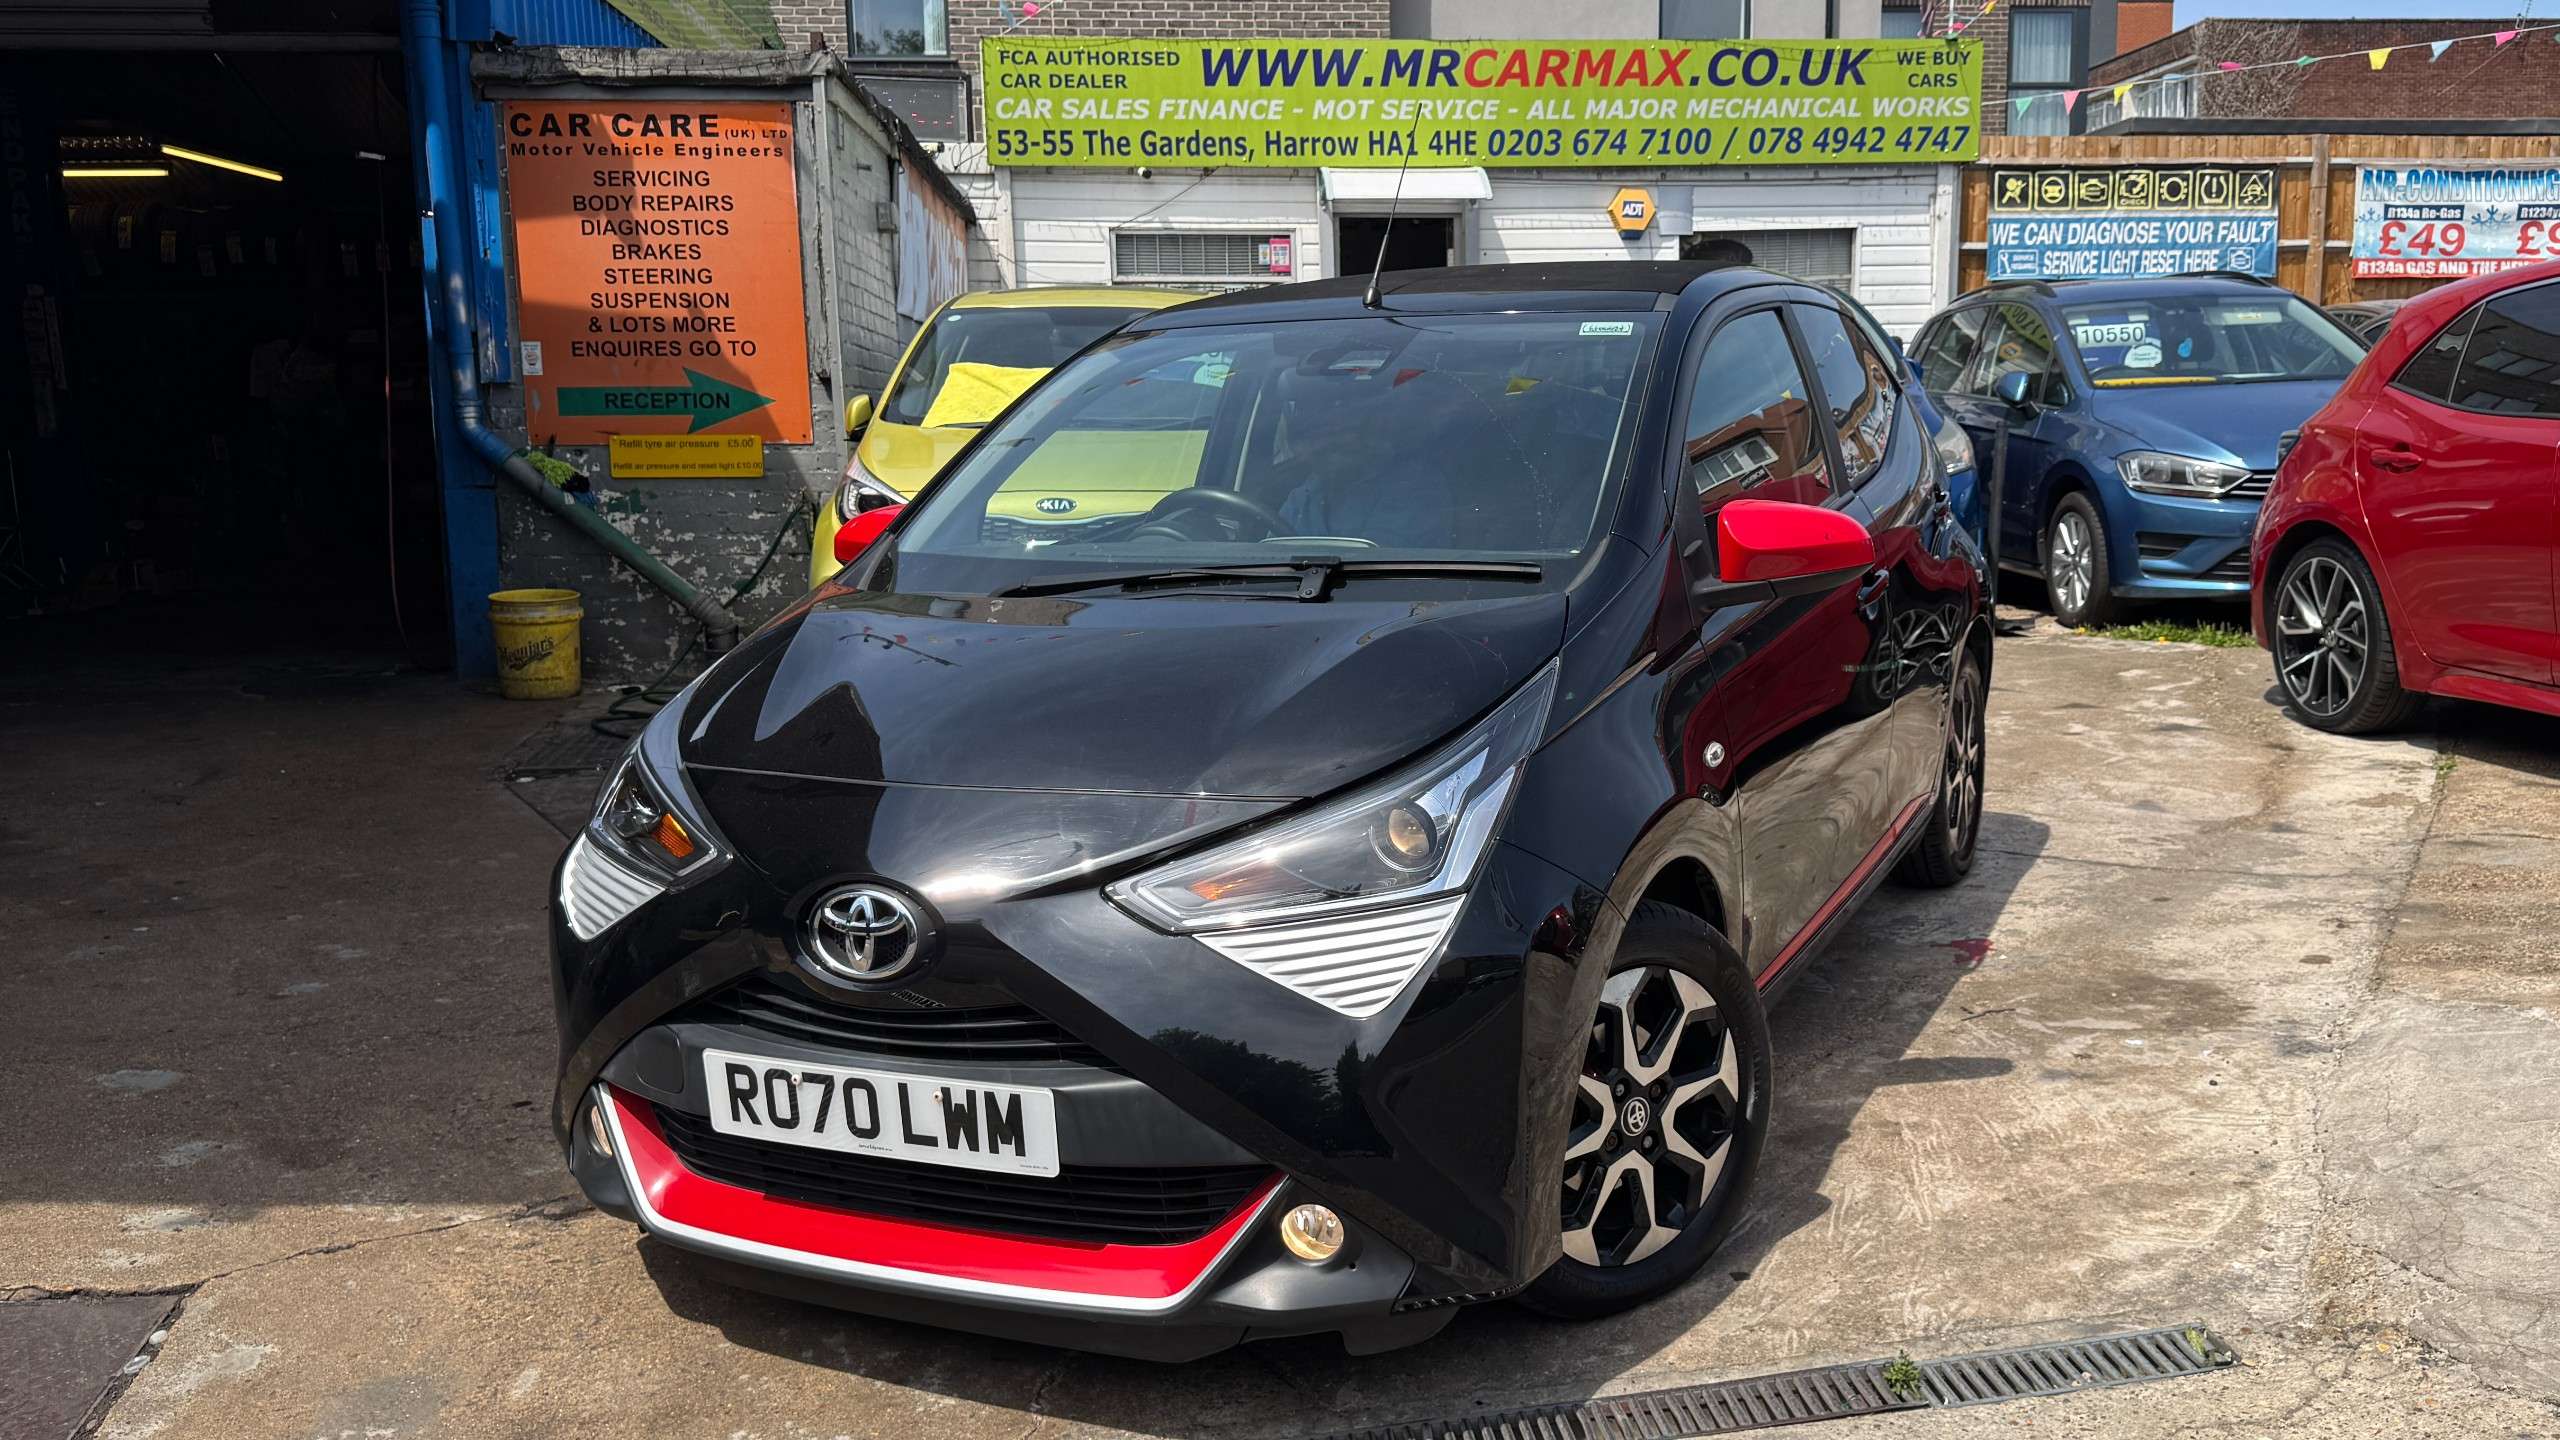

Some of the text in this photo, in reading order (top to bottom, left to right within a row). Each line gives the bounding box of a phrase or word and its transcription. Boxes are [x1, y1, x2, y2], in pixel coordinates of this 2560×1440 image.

[999, 50, 1181, 67] FCA AUTHORISED
[1897, 51, 1972, 66] WE BUY
[1201, 48, 1873, 88] WWW.MRCARMAX.CO.UK
[1000, 73, 1128, 89] CAR DEALER
[1907, 73, 1958, 88] CARS
[996, 98, 1052, 120] CAR
[1062, 98, 1150, 120] SALES
[1158, 98, 1283, 120] FINANCE
[1312, 98, 1373, 120] MOT
[1382, 98, 1501, 120] SERVICE
[1527, 98, 1582, 120] ALL
[1585, 97, 1678, 120] MAJOR
[1686, 96, 1862, 119] MECHANICAL
[1872, 95, 1971, 118] WORKS
[510, 113, 788, 141] CAR CARE (UK) LTD
[510, 142, 784, 160] Motor Vehicle Engineers
[997, 125, 1971, 162] 53-55 The Gardens, Harrow HA1 4HE 0203 674 7100 / 078 4942 4747
[593, 170, 710, 187] SERVICING
[572, 195, 734, 212] BODY REPAIRS
[1622, 203, 1645, 216] ADT
[2387, 206, 2461, 219] R134a Re-Gas
[581, 219, 729, 236] DIAGNOSTICS
[1992, 220, 2275, 245] WE CAN DIAGNOSE YOUR FAULT
[2378, 220, 2466, 257] £49
[612, 244, 701, 260] BRAKES
[2043, 250, 2100, 274] SERVICE
[2101, 250, 2140, 273] LIGHT
[2141, 250, 2182, 273] RESET
[2184, 250, 2219, 272] HERE
[2358, 261, 2404, 275] R134a
[2406, 261, 2436, 275] GAS
[2438, 261, 2468, 275] AND
[2471, 260, 2498, 275] THE
[604, 268, 713, 285] STEERING
[591, 292, 730, 309] SUSPENSION
[588, 316, 735, 333] & LOTS MORE
[2081, 326, 2144, 344] 10550
[571, 340, 756, 358] ENQUIRES GO TO
[604, 392, 730, 409] RECEPTION
[619, 439, 754, 450] Refill tyre air pressure £5.00
[646, 463, 680, 471] pressure
[1042, 500, 1070, 510] KIA
[725, 1062, 1026, 1158] RO70 LWM
